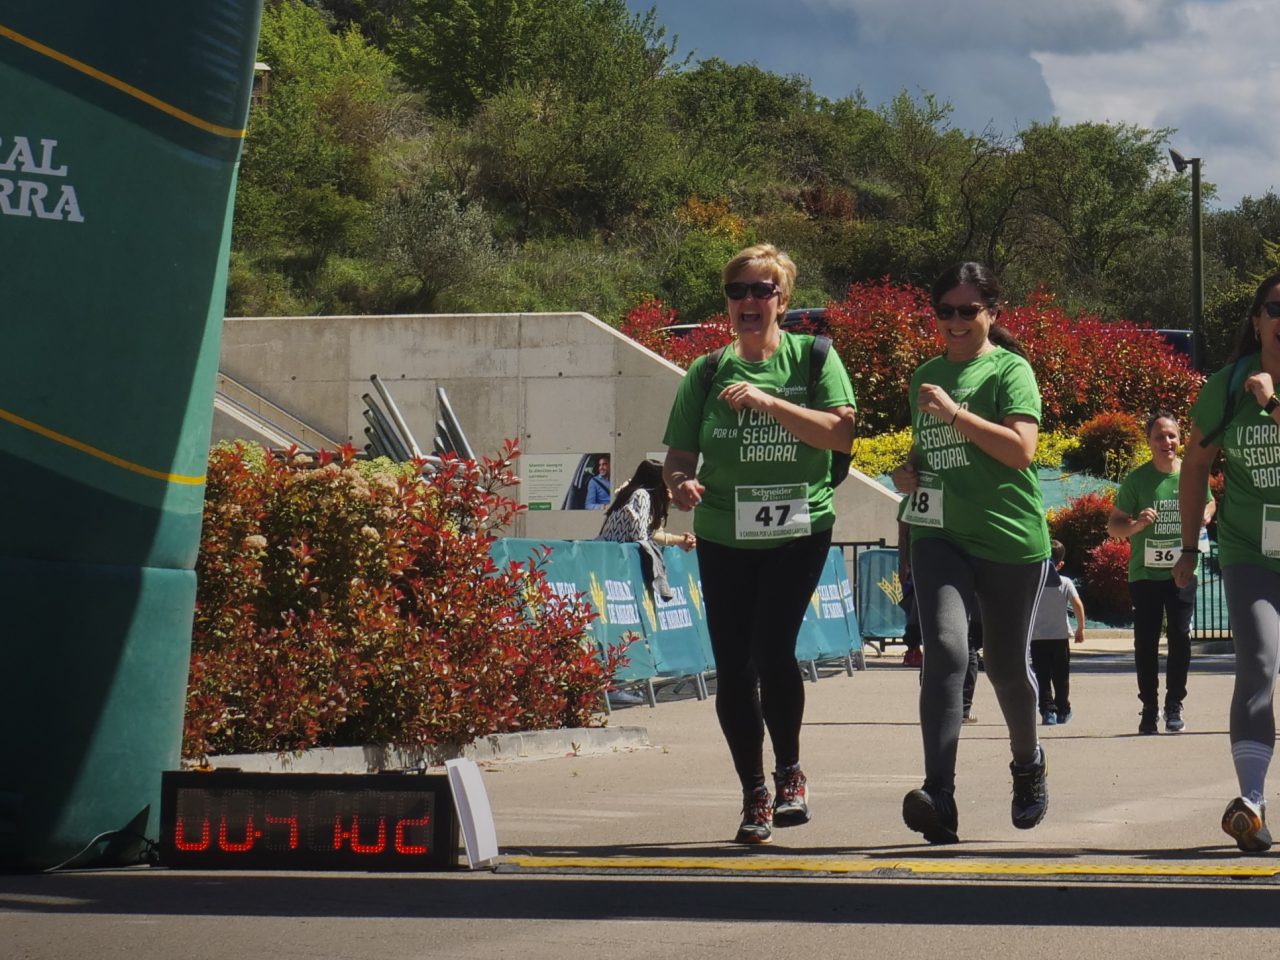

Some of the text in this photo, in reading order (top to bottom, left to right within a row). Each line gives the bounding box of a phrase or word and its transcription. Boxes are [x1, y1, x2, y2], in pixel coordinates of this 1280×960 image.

[712, 428, 728, 439] POR
[729, 428, 738, 439] LA
[1237, 426, 1244, 446] V
[740, 445, 797, 462] LABORAL
[752, 488, 792, 499] Schneider
[755, 504, 791, 527] 47
[1154, 550, 1174, 562] 36
